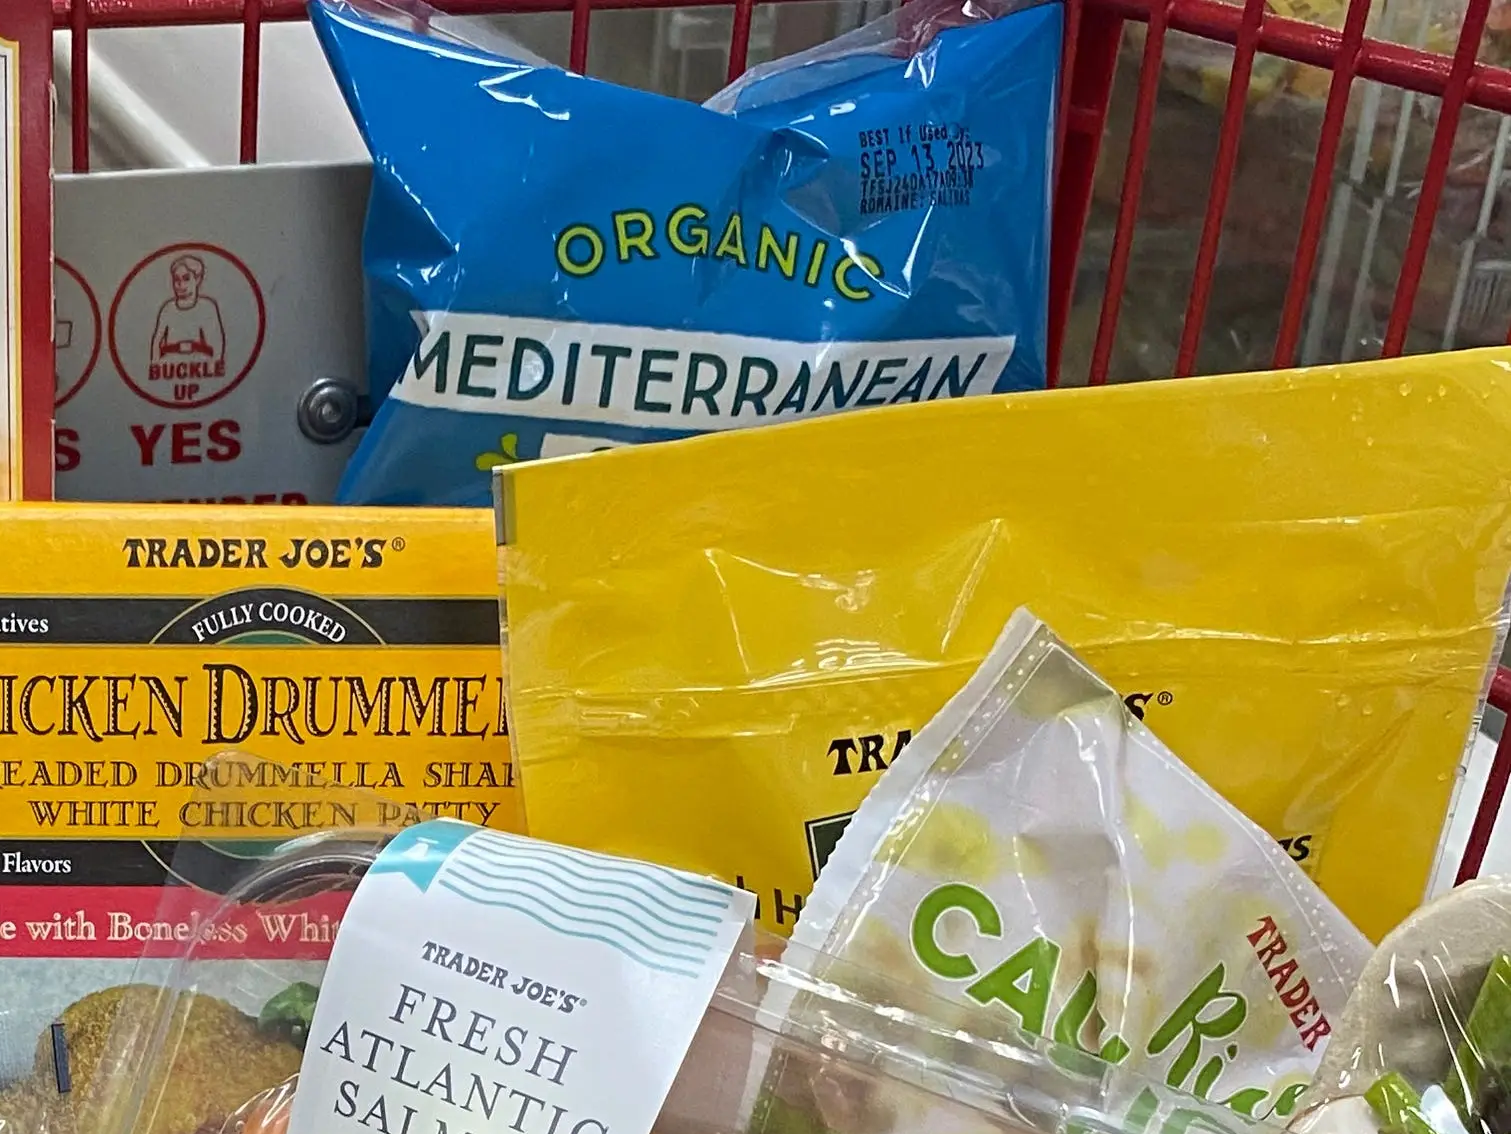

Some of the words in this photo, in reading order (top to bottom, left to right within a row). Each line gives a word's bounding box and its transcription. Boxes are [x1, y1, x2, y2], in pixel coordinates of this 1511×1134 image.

[859, 128, 889, 148] BEST
[919, 123, 948, 141] Used
[860, 148, 897, 178] SEP
[911, 144, 935, 175] 13
[947, 141, 984, 171] 2023
[555, 205, 883, 301] ORGANIC
[148, 359, 225, 381] BUCKLE
[400, 330, 987, 418] MEDITERRANEAN
[174, 383, 199, 401] UP
[130, 420, 242, 466] YES
[123, 539, 267, 569] TRADER
[190, 602, 256, 642] FULLY
[258, 602, 348, 642] COOKED
[157, 761, 403, 789] DRUMMELLA
[29, 801, 159, 828] WHITE
[180, 802, 359, 829] CHICKEN
[379, 801, 500, 826] PATTY
[19, 853, 71, 875] Flavors
[26, 911, 96, 942] with
[109, 911, 247, 942] Boneless
[421, 941, 510, 989] TRADER
[1247, 915, 1332, 1052] TRADER
[389, 983, 578, 1086] FRESH
